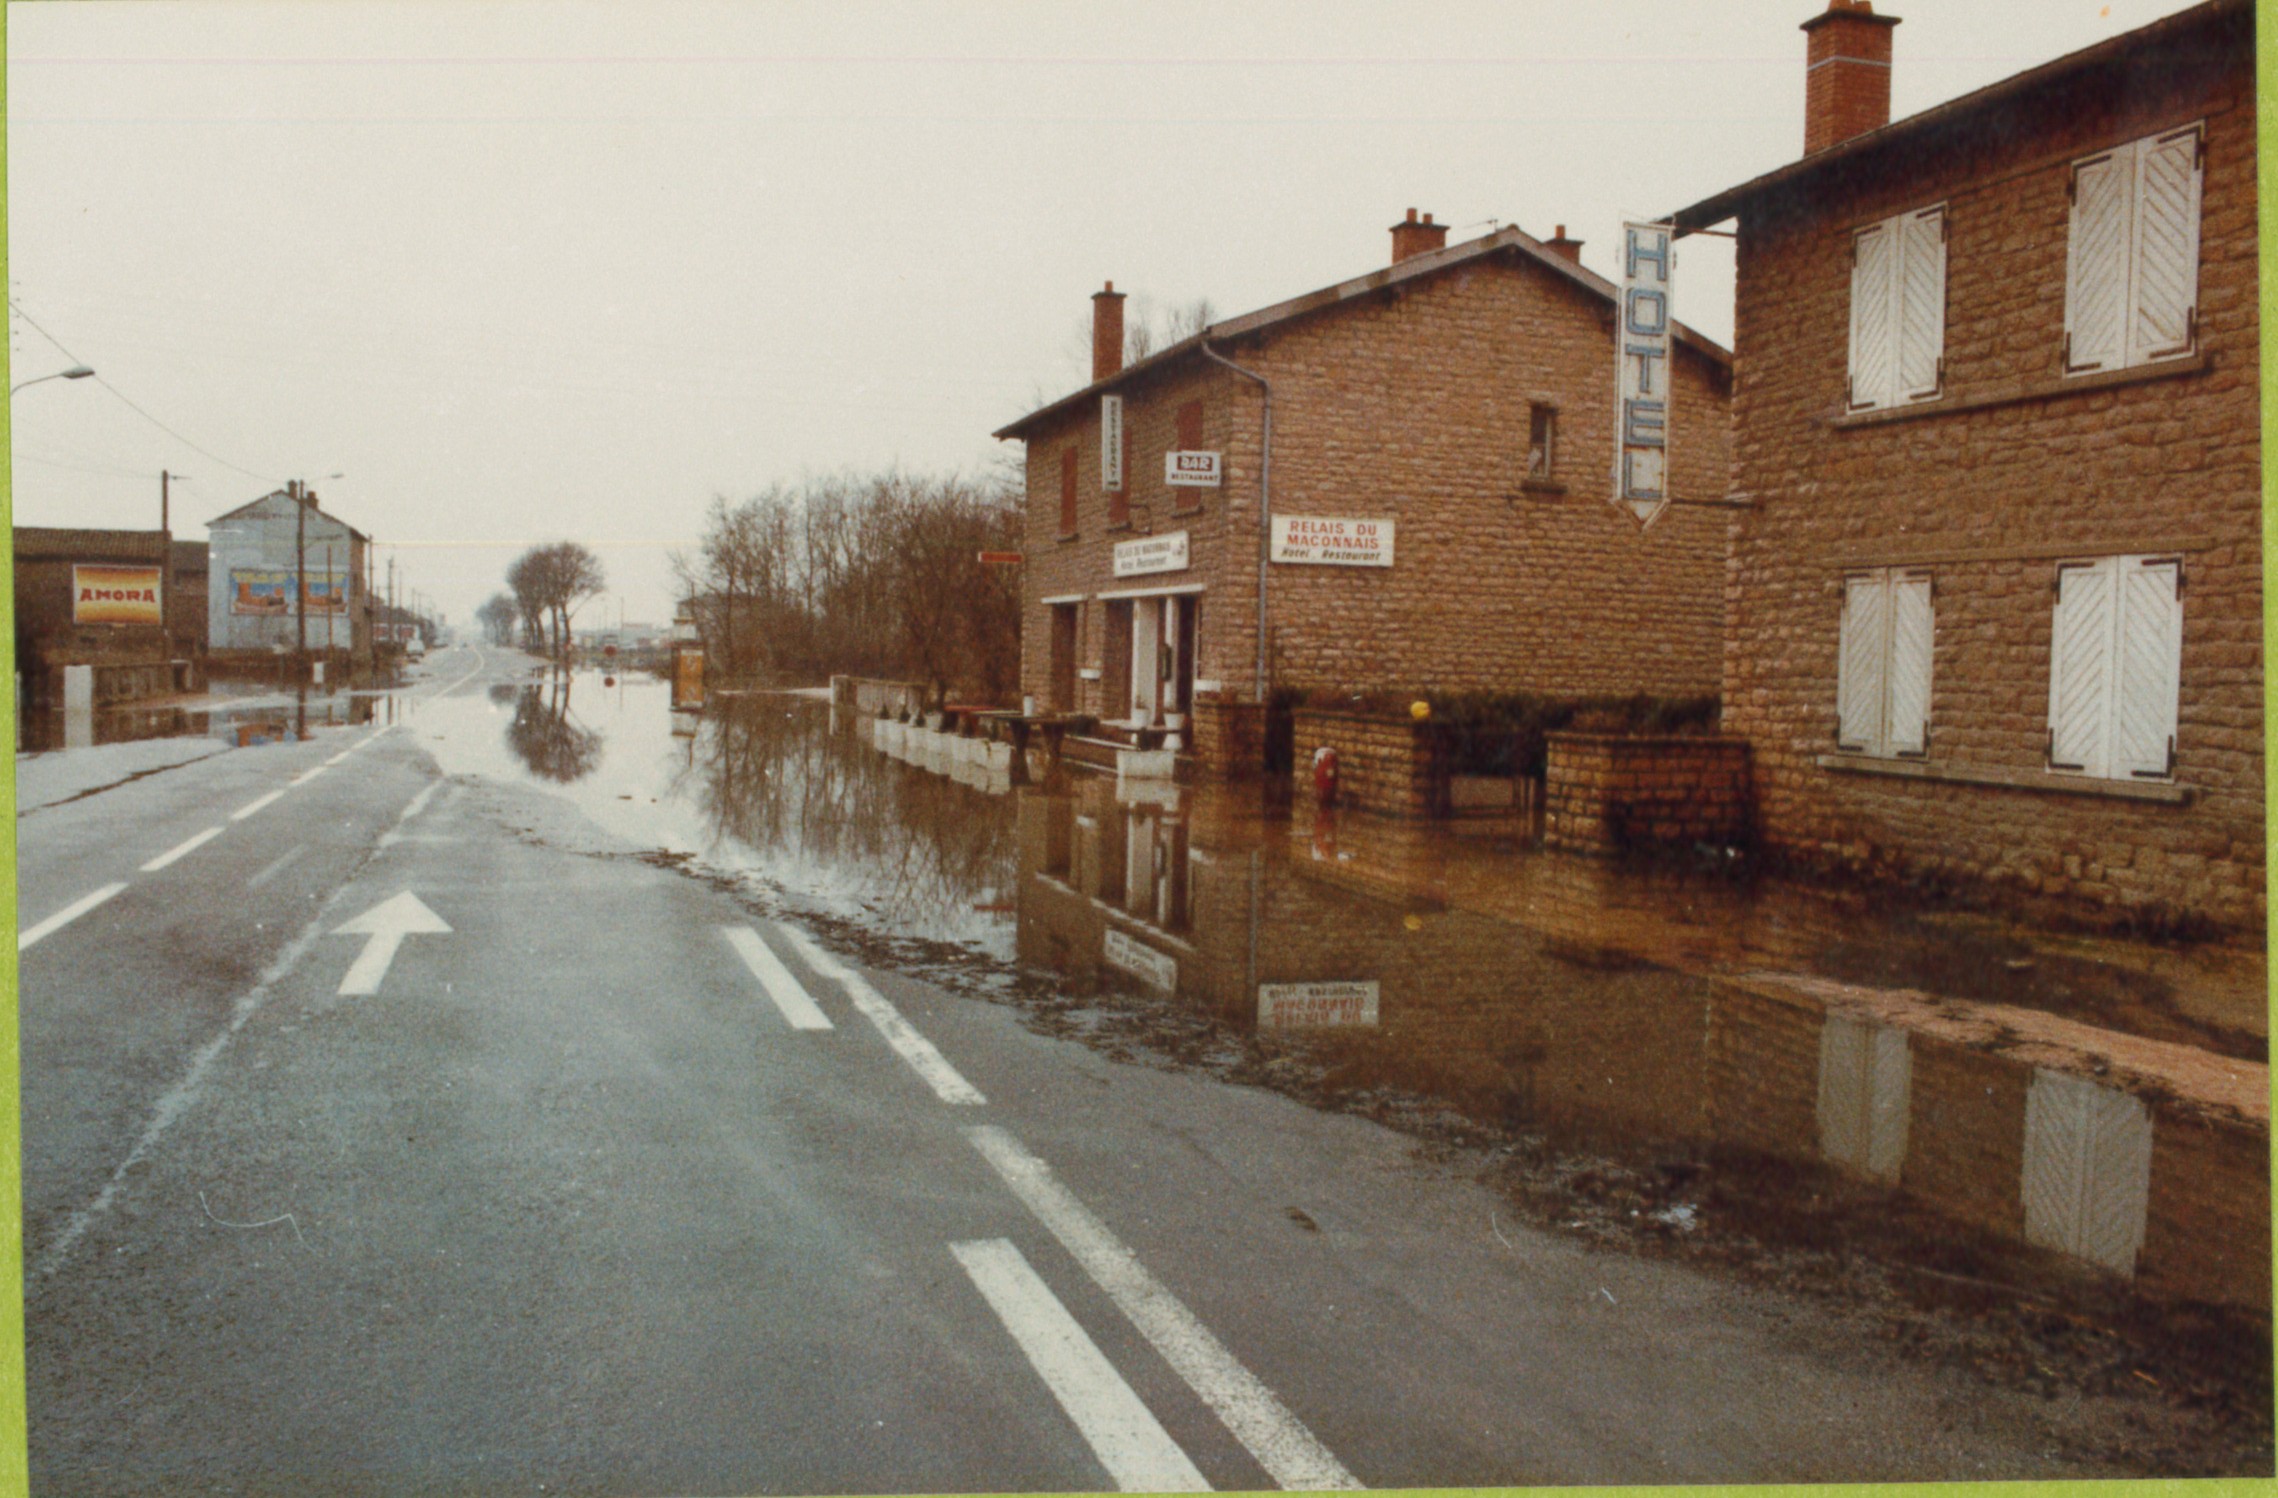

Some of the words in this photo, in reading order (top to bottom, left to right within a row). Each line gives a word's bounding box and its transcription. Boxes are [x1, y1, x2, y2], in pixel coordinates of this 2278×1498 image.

[1625, 229, 1667, 498] HOTEL
[1180, 457, 1211, 469] BAR
[1171, 472, 1218, 481] RESTAURANT
[1290, 520, 1345, 535] RELAIS
[1356, 523, 1377, 536] DU
[1287, 534, 1379, 550] MACONNAIS
[1321, 548, 1380, 561] Restaurant
[80, 588, 156, 603] AMORA
